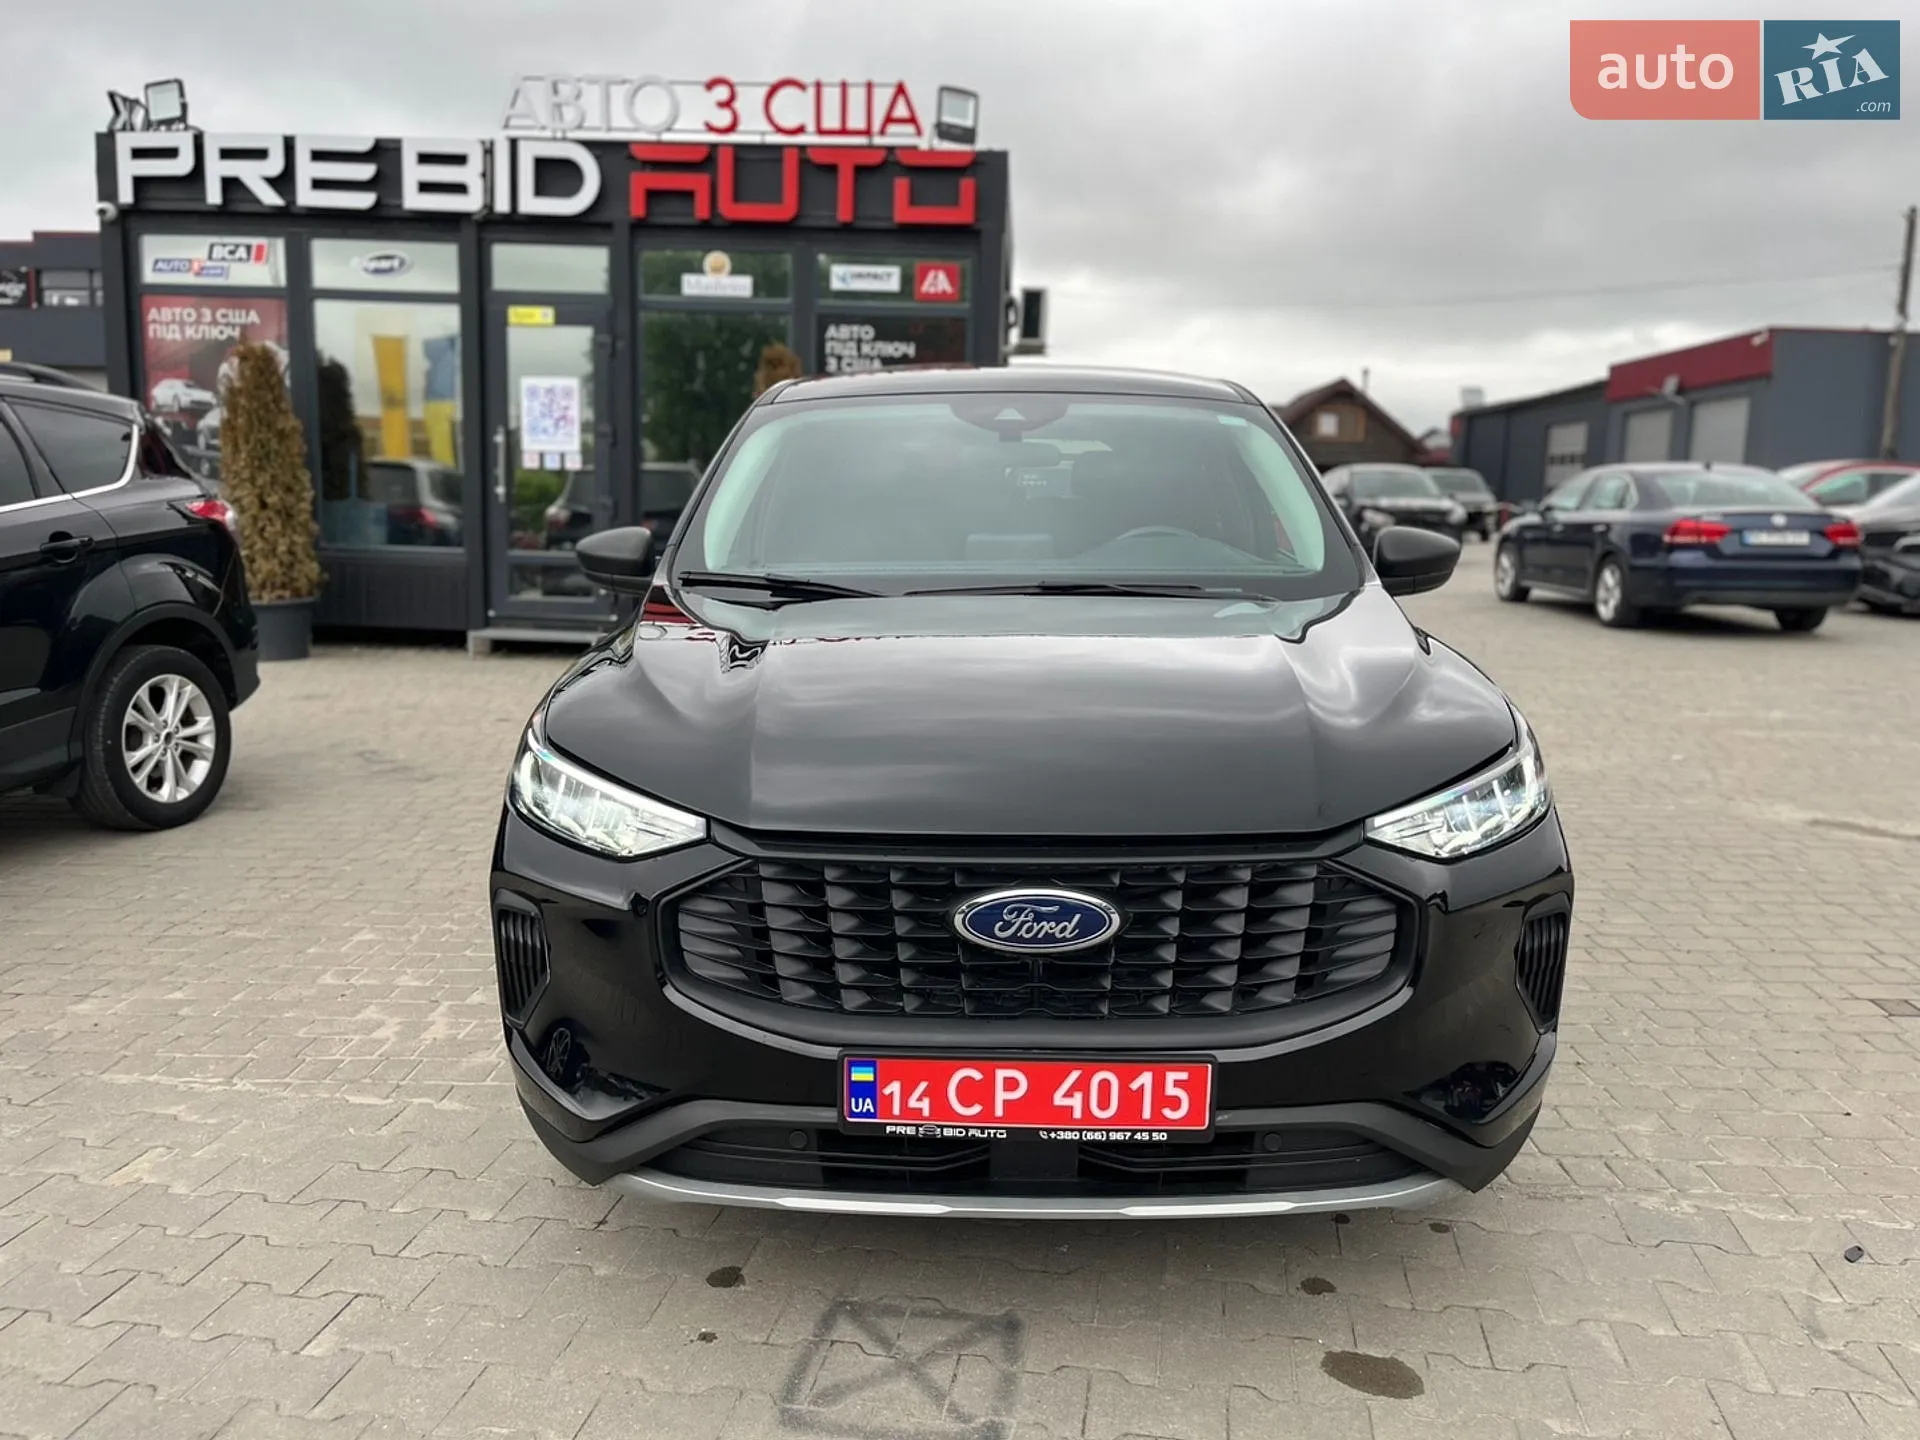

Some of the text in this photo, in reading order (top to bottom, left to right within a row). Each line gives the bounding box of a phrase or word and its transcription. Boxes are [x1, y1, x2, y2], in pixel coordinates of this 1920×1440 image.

[502, 76, 923, 137] АВТО З США
[115, 131, 976, 224] PRE BID AUTO
[148, 307, 197, 323] АВТО
[215, 308, 260, 324] США
[148, 324, 240, 341] ПІД КЛЮЧ
[824, 324, 876, 340] АВТО
[825, 340, 916, 358] ПІД КЛЮЧ
[840, 357, 883, 372] США
[993, 903, 1082, 939] Ford
[882, 1067, 1190, 1120] 14 CP 4015
[851, 1098, 875, 1113] UA
[886, 1125, 1007, 1138] PRE BID AUTO
[1049, 1131, 1167, 1141] +380 (66) 967 45 50
